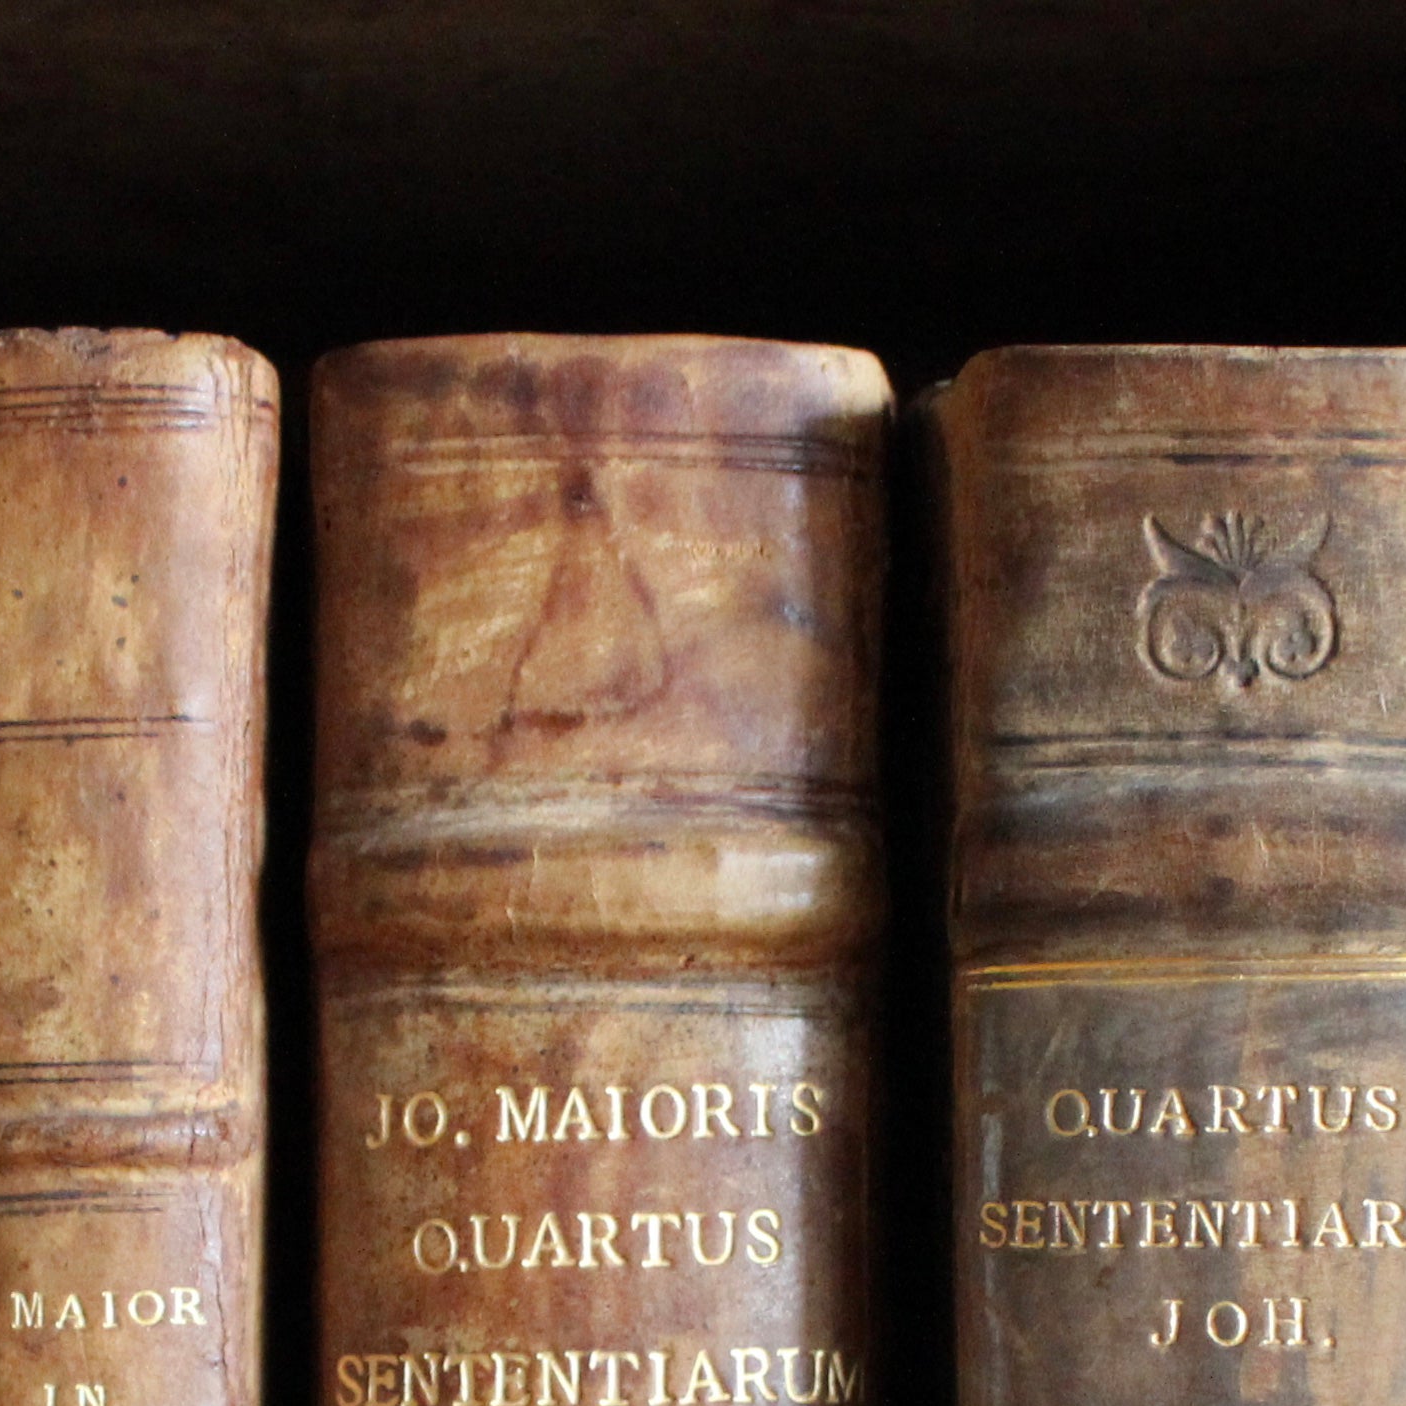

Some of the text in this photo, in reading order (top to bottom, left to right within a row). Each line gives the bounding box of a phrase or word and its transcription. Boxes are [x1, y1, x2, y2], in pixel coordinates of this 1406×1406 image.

[365, 1082, 824, 1150] JO. MAIORIS
[1046, 1086, 1399, 1138] QUARTUS
[413, 1209, 782, 1275] QUARTUS
[10, 1286, 207, 1331] MAIOR
[1151, 1297, 1336, 1350] JOH.
